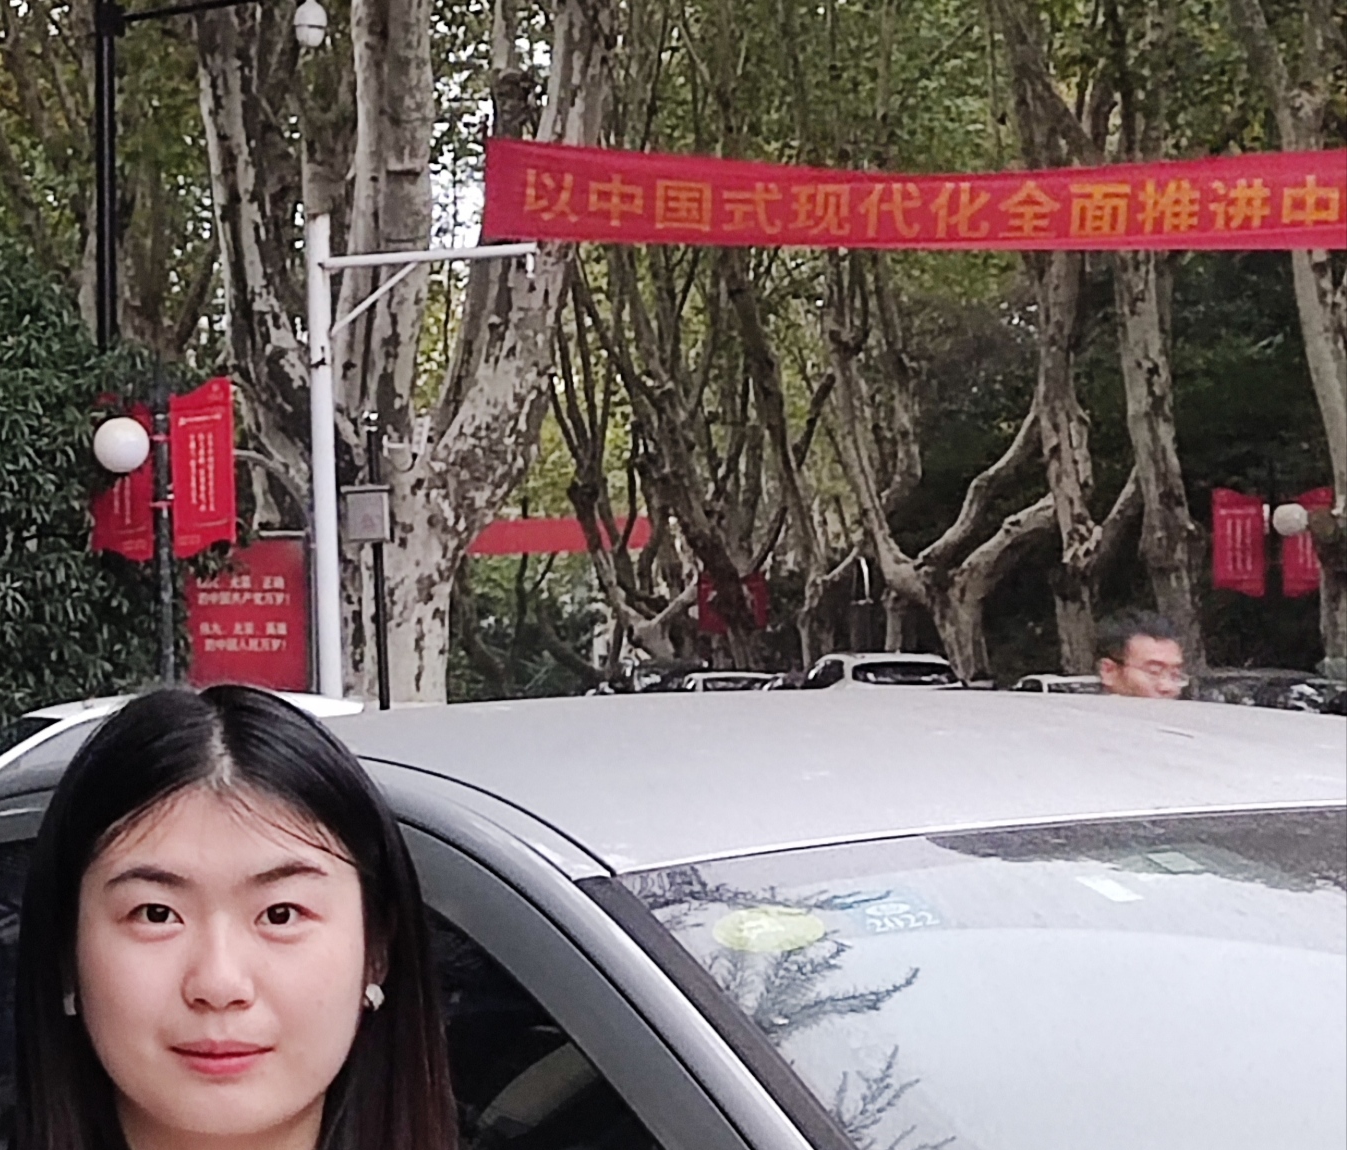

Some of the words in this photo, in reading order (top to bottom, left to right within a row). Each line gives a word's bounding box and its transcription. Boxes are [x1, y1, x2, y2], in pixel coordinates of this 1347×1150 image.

[522, 167, 1341, 239] 以中国式现代化全面推进中
